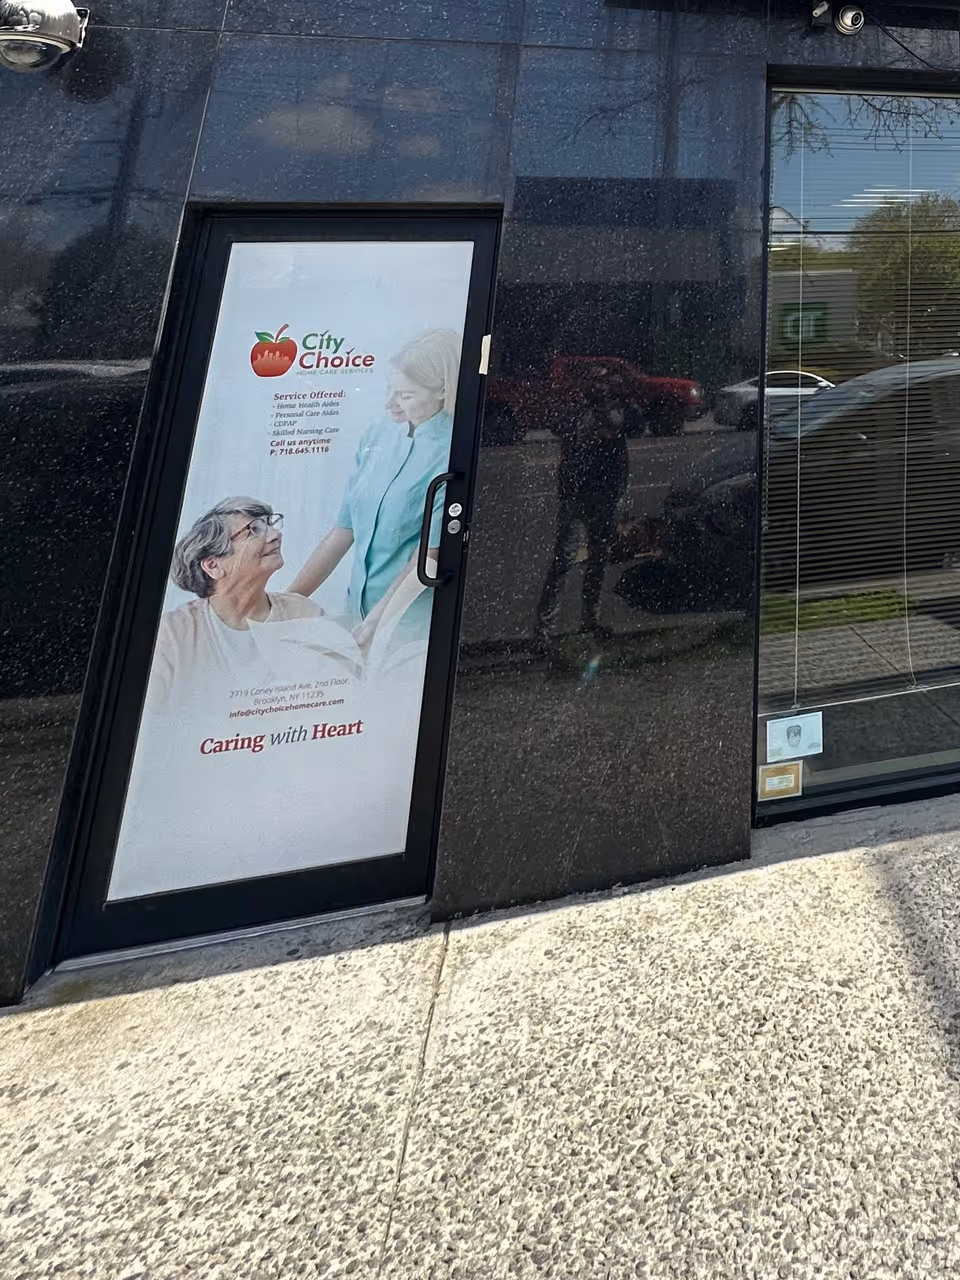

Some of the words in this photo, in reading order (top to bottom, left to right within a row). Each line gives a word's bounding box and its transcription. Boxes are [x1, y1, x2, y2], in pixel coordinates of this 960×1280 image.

[302, 330, 345, 354] City
[299, 347, 375, 369] Choice
[274, 392, 307, 401] Service
[310, 390, 346, 399] Offered:
[299, 400, 320, 409] Health
[275, 410, 304, 418] Personal
[296, 427, 323, 436] Nursing
[270, 439, 286, 447] Call
[298, 437, 332, 447] anytime
[279, 446, 330, 455] 718.645.1116
[229, 689, 249, 699] 2719
[250, 686, 274, 697] Coney
[275, 683, 297, 693] Island
[314, 678, 329, 688] 2nd
[289, 693, 301, 701] NY
[301, 690, 325, 700] 11235
[200, 733, 267, 755] Caring
[270, 725, 308, 746] with
[311, 718, 364, 740] Heart
